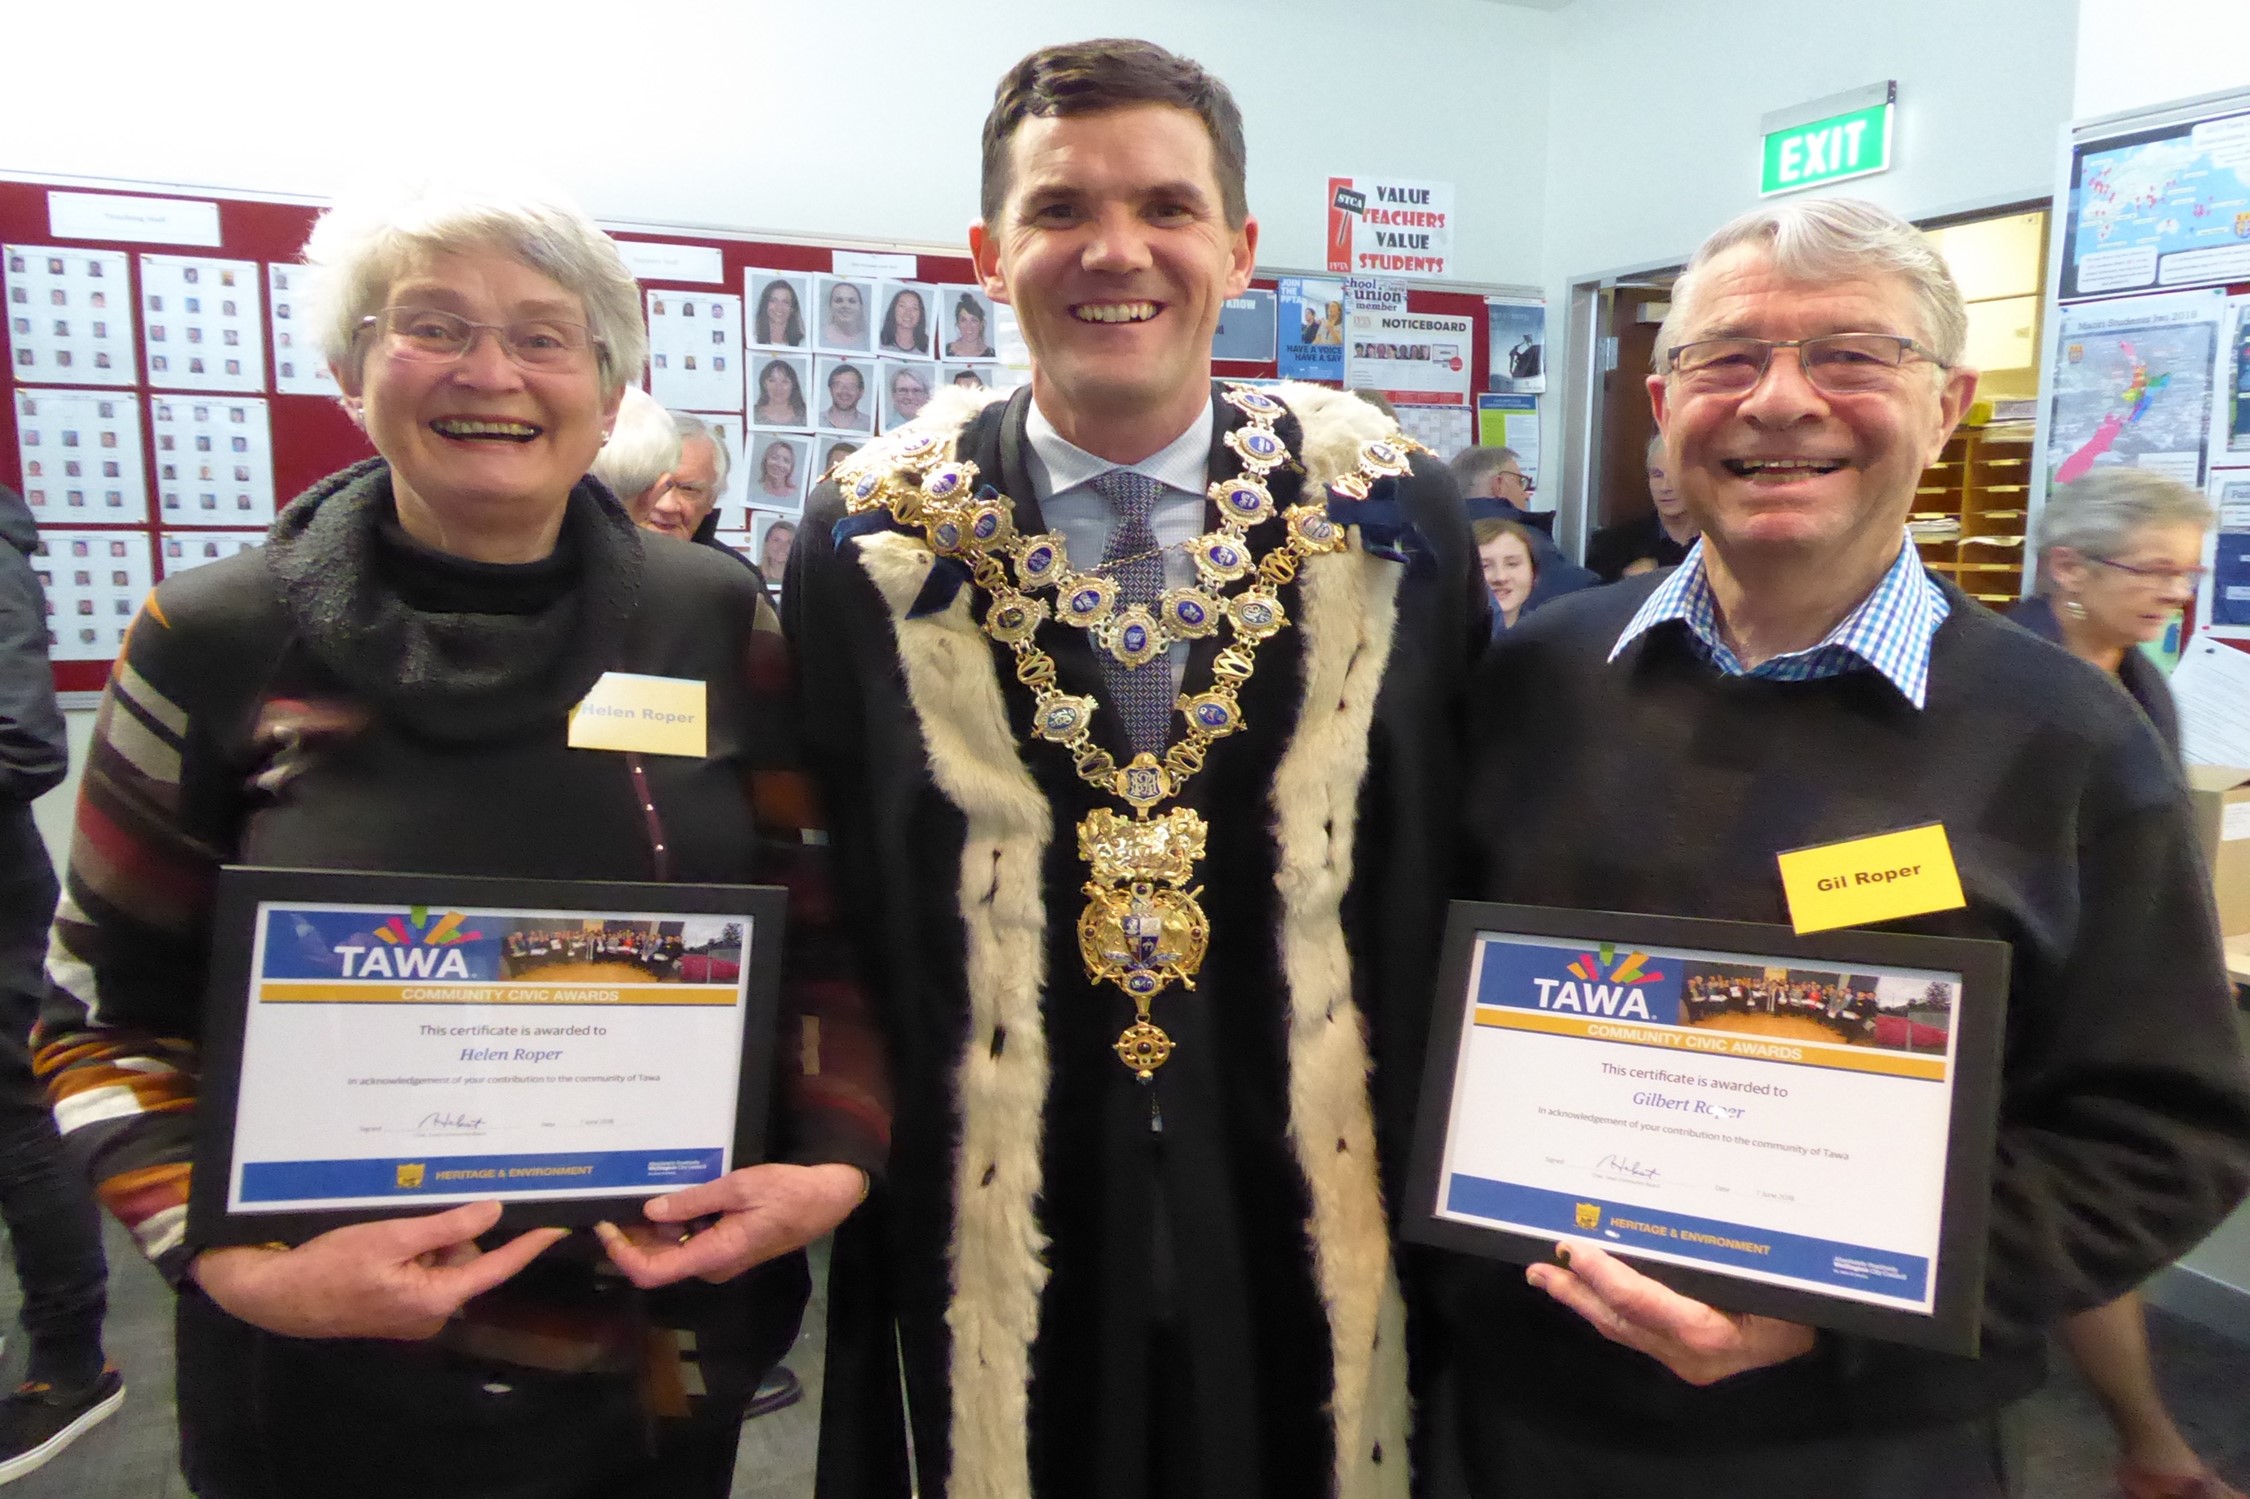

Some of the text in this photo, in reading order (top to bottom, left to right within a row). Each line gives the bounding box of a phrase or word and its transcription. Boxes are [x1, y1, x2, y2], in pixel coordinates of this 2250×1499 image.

[1779, 119, 1867, 183] EXIT
[1338, 193, 1363, 209] STCA
[1376, 186, 1430, 205] VALUE
[1362, 208, 1446, 228] TEACHERS
[1375, 231, 1430, 250] VALUE
[1329, 262, 1349, 271] PPTA
[1359, 253, 1444, 273] STUDENTS
[1281, 279, 1301, 287] JOIN
[1281, 287, 1298, 295] THE
[1345, 277, 1376, 289] chool
[1354, 287, 1402, 303] union
[1356, 302, 1397, 311] member
[1382, 318, 1467, 332] NOTICEBOARD
[1287, 345, 1308, 353] HAVE
[1319, 346, 1342, 355] VOICE
[1295, 353, 1316, 361] HAVE
[1327, 354, 1342, 362] SAY
[581, 703, 695, 724] Helen Roper
[1817, 864, 1922, 892] Gil Roper
[334, 945, 469, 979] TAWA
[401, 988, 620, 1002] COMMUNITY CIVIC AWARDS
[1533, 977, 1650, 1020] TAWA
[419, 1024, 607, 1037] This certificate is awarded to
[1587, 1024, 1803, 1060] COMMUNITY CIVIC AWARDS
[459, 1048, 563, 1063] Helen Roper
[348, 1074, 661, 1087] In acknowledgement of your contribution to the community of Tawa
[1601, 1062, 1789, 1097] This certificate is awarded to
[1633, 1091, 1690, 1112] Gilbert
[1538, 1106, 1849, 1160] In acknowledgement of your contribution to the community of Tawa
[435, 1165, 594, 1180] HERITAGE & ENVIRONMENT
[1610, 1217, 1771, 1255] HERITAGE & ENVIRONMENT
